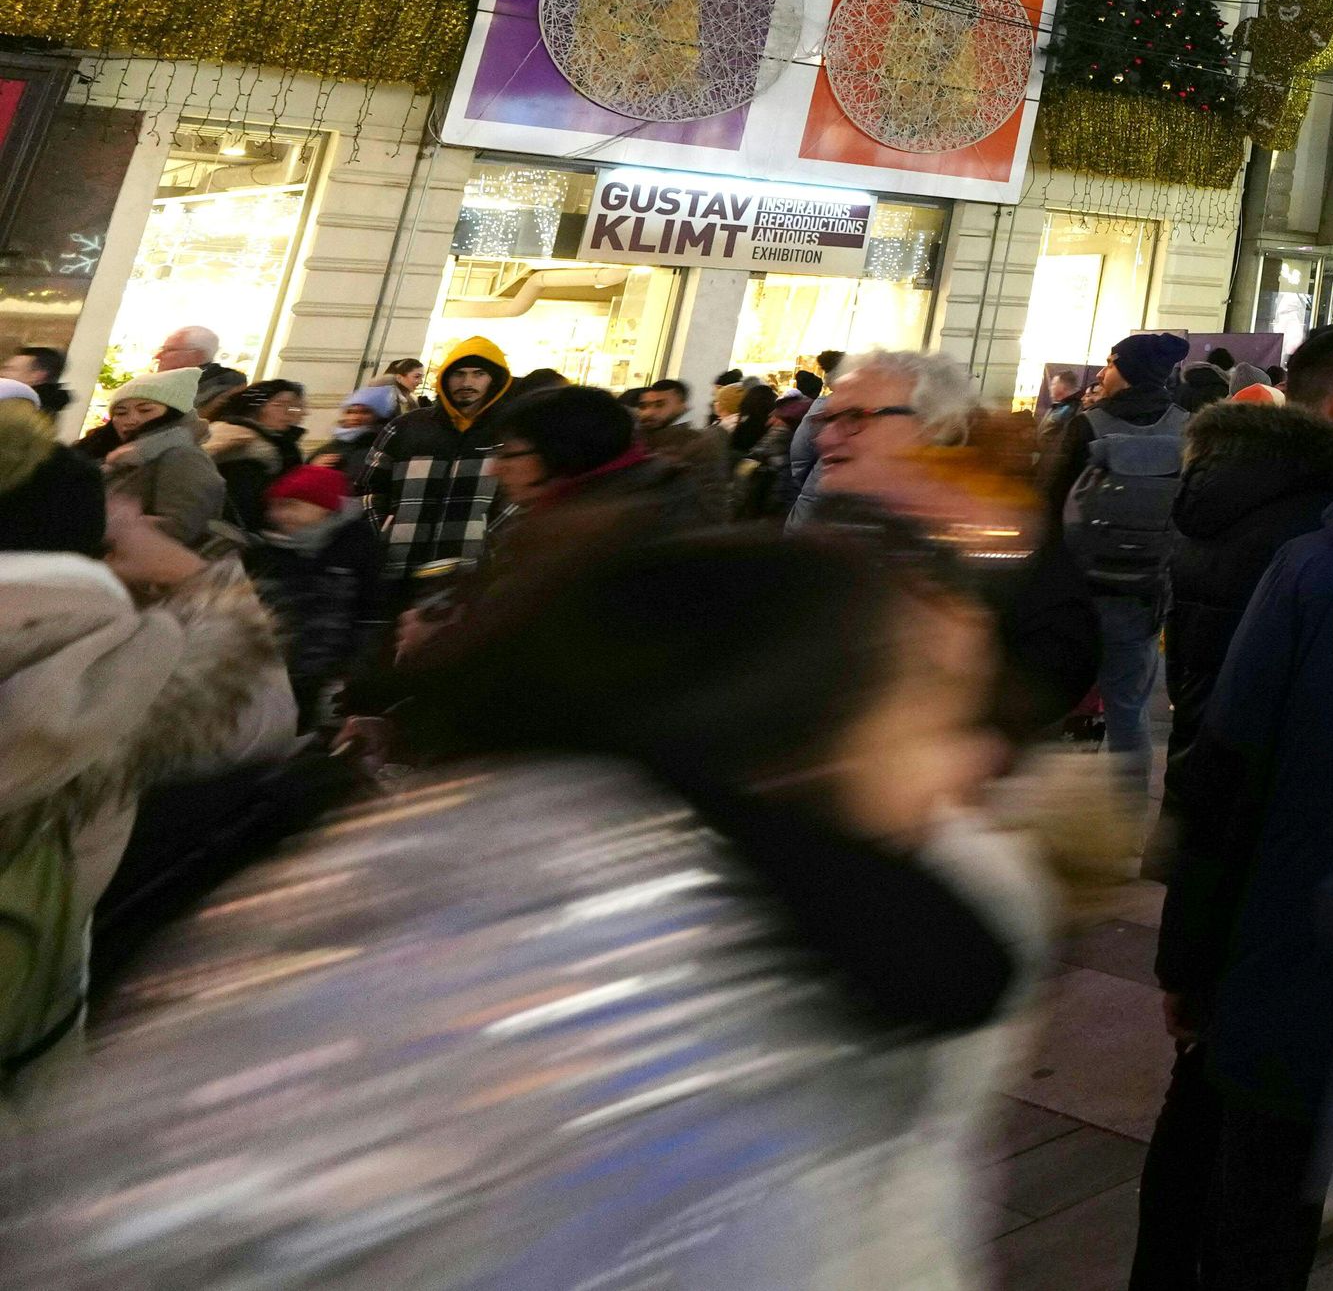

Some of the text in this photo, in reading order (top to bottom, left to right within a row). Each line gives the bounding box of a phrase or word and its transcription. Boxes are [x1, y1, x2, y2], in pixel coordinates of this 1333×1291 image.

[600, 182, 753, 221] GUSTAV
[761, 196, 852, 219] INSPIRATIONS
[758, 212, 865, 235] REPRODUCTIONS
[590, 213, 749, 258] KLIMT
[755, 229, 820, 247] ANTIQUES
[751, 245, 823, 264] EXHIBITION
